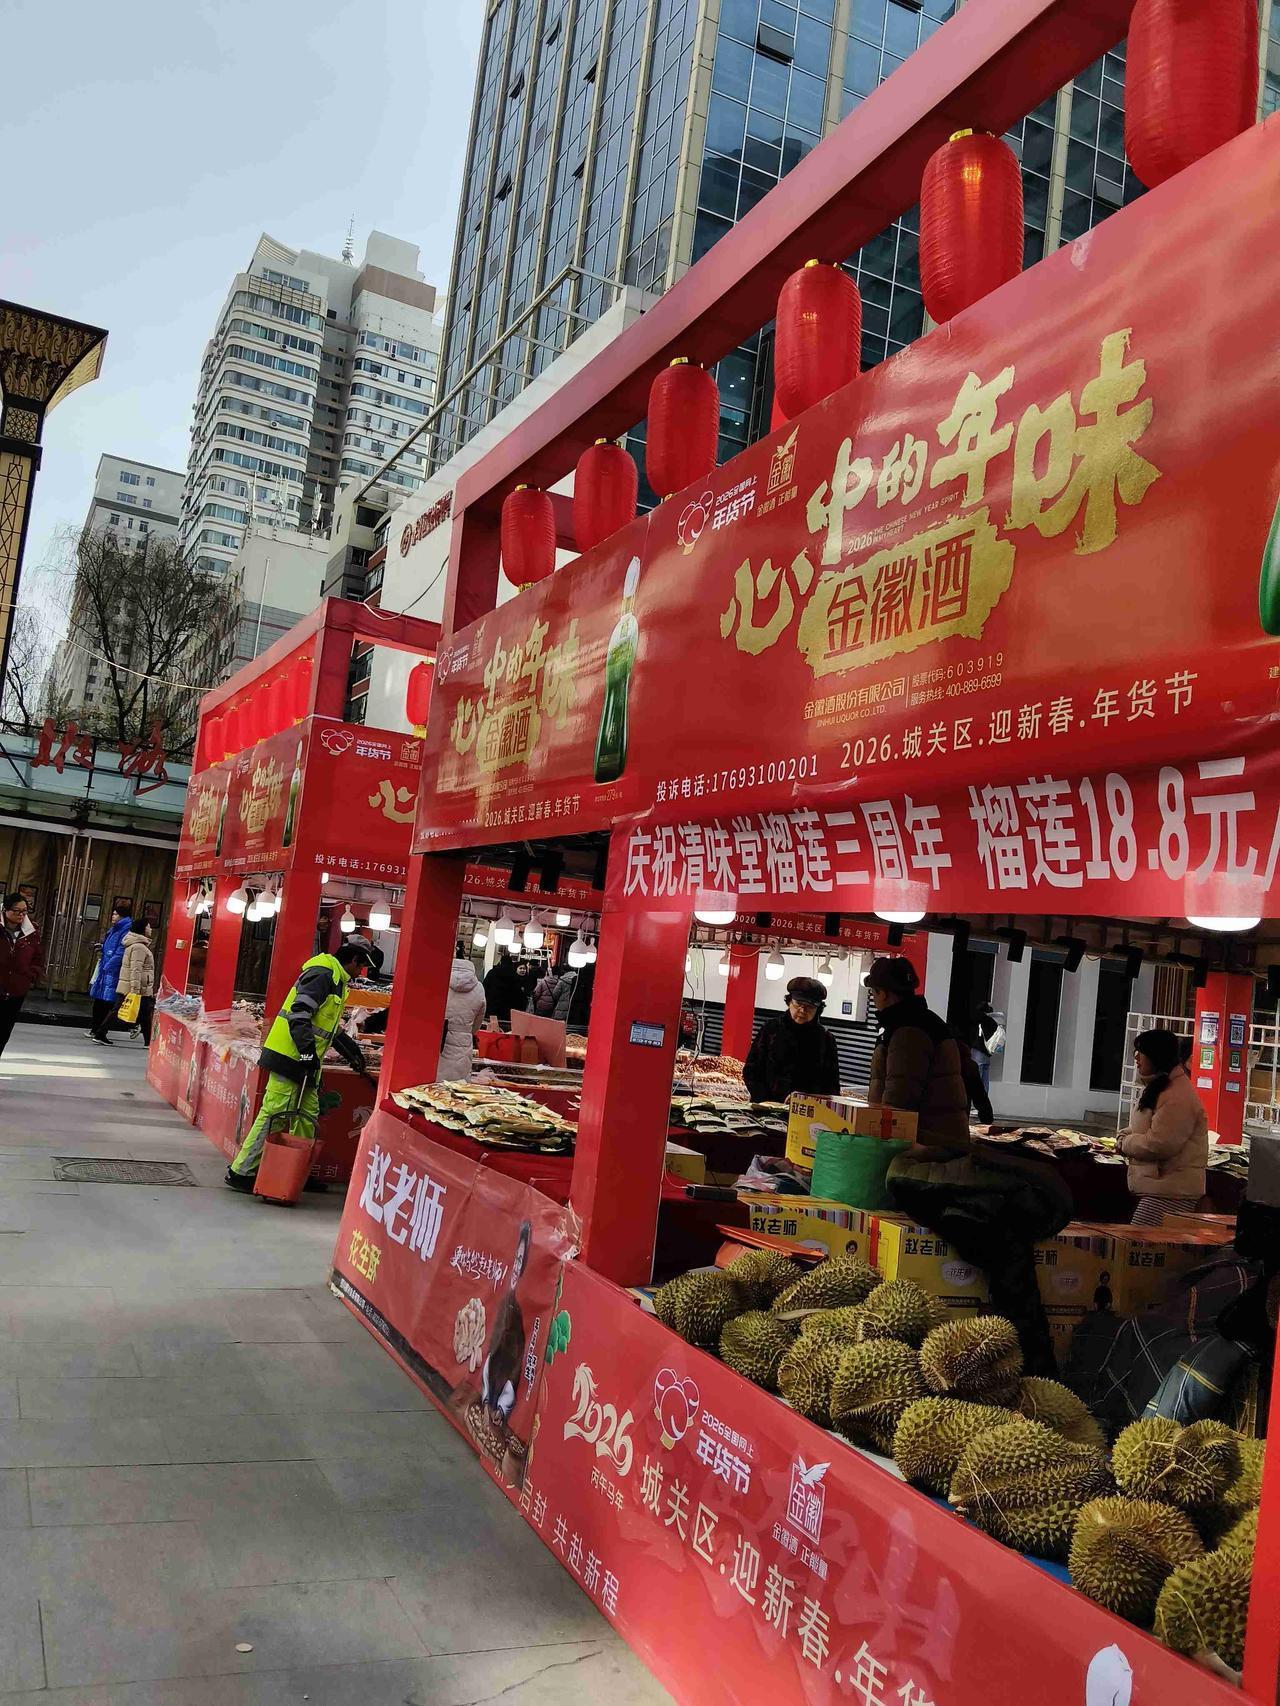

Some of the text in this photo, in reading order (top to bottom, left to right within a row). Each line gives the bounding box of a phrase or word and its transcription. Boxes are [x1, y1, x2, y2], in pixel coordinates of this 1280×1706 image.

[712, 490, 755, 530] 年货节
[848, 530, 873, 555] 2026
[823, 529, 975, 660] 金徽酒
[803, 677, 906, 720] 金徽酒股份有限公司
[656, 754, 818, 803] 投诉电话:17693100201
[623, 793, 953, 897] 庆祝清味堂榴莲三周年
[791, 1101, 815, 1118] 赵老师
[359, 1143, 448, 1262] 赵老师
[752, 1217, 798, 1237] 赵老师
[348, 1228, 383, 1285] 花生酥
[904, 1238, 949, 1257] 赵老师
[1128, 1251, 1166, 1267] 赵老师
[564, 1362, 635, 1477] 2026
[701, 1409, 755, 1460] 2026全国网上
[696, 1428, 752, 1495] 年货节
[590, 1466, 625, 1512] 丙午马年
[788, 1481, 821, 1538] 金徽
[552, 1513, 620, 1617] 共赴新程
